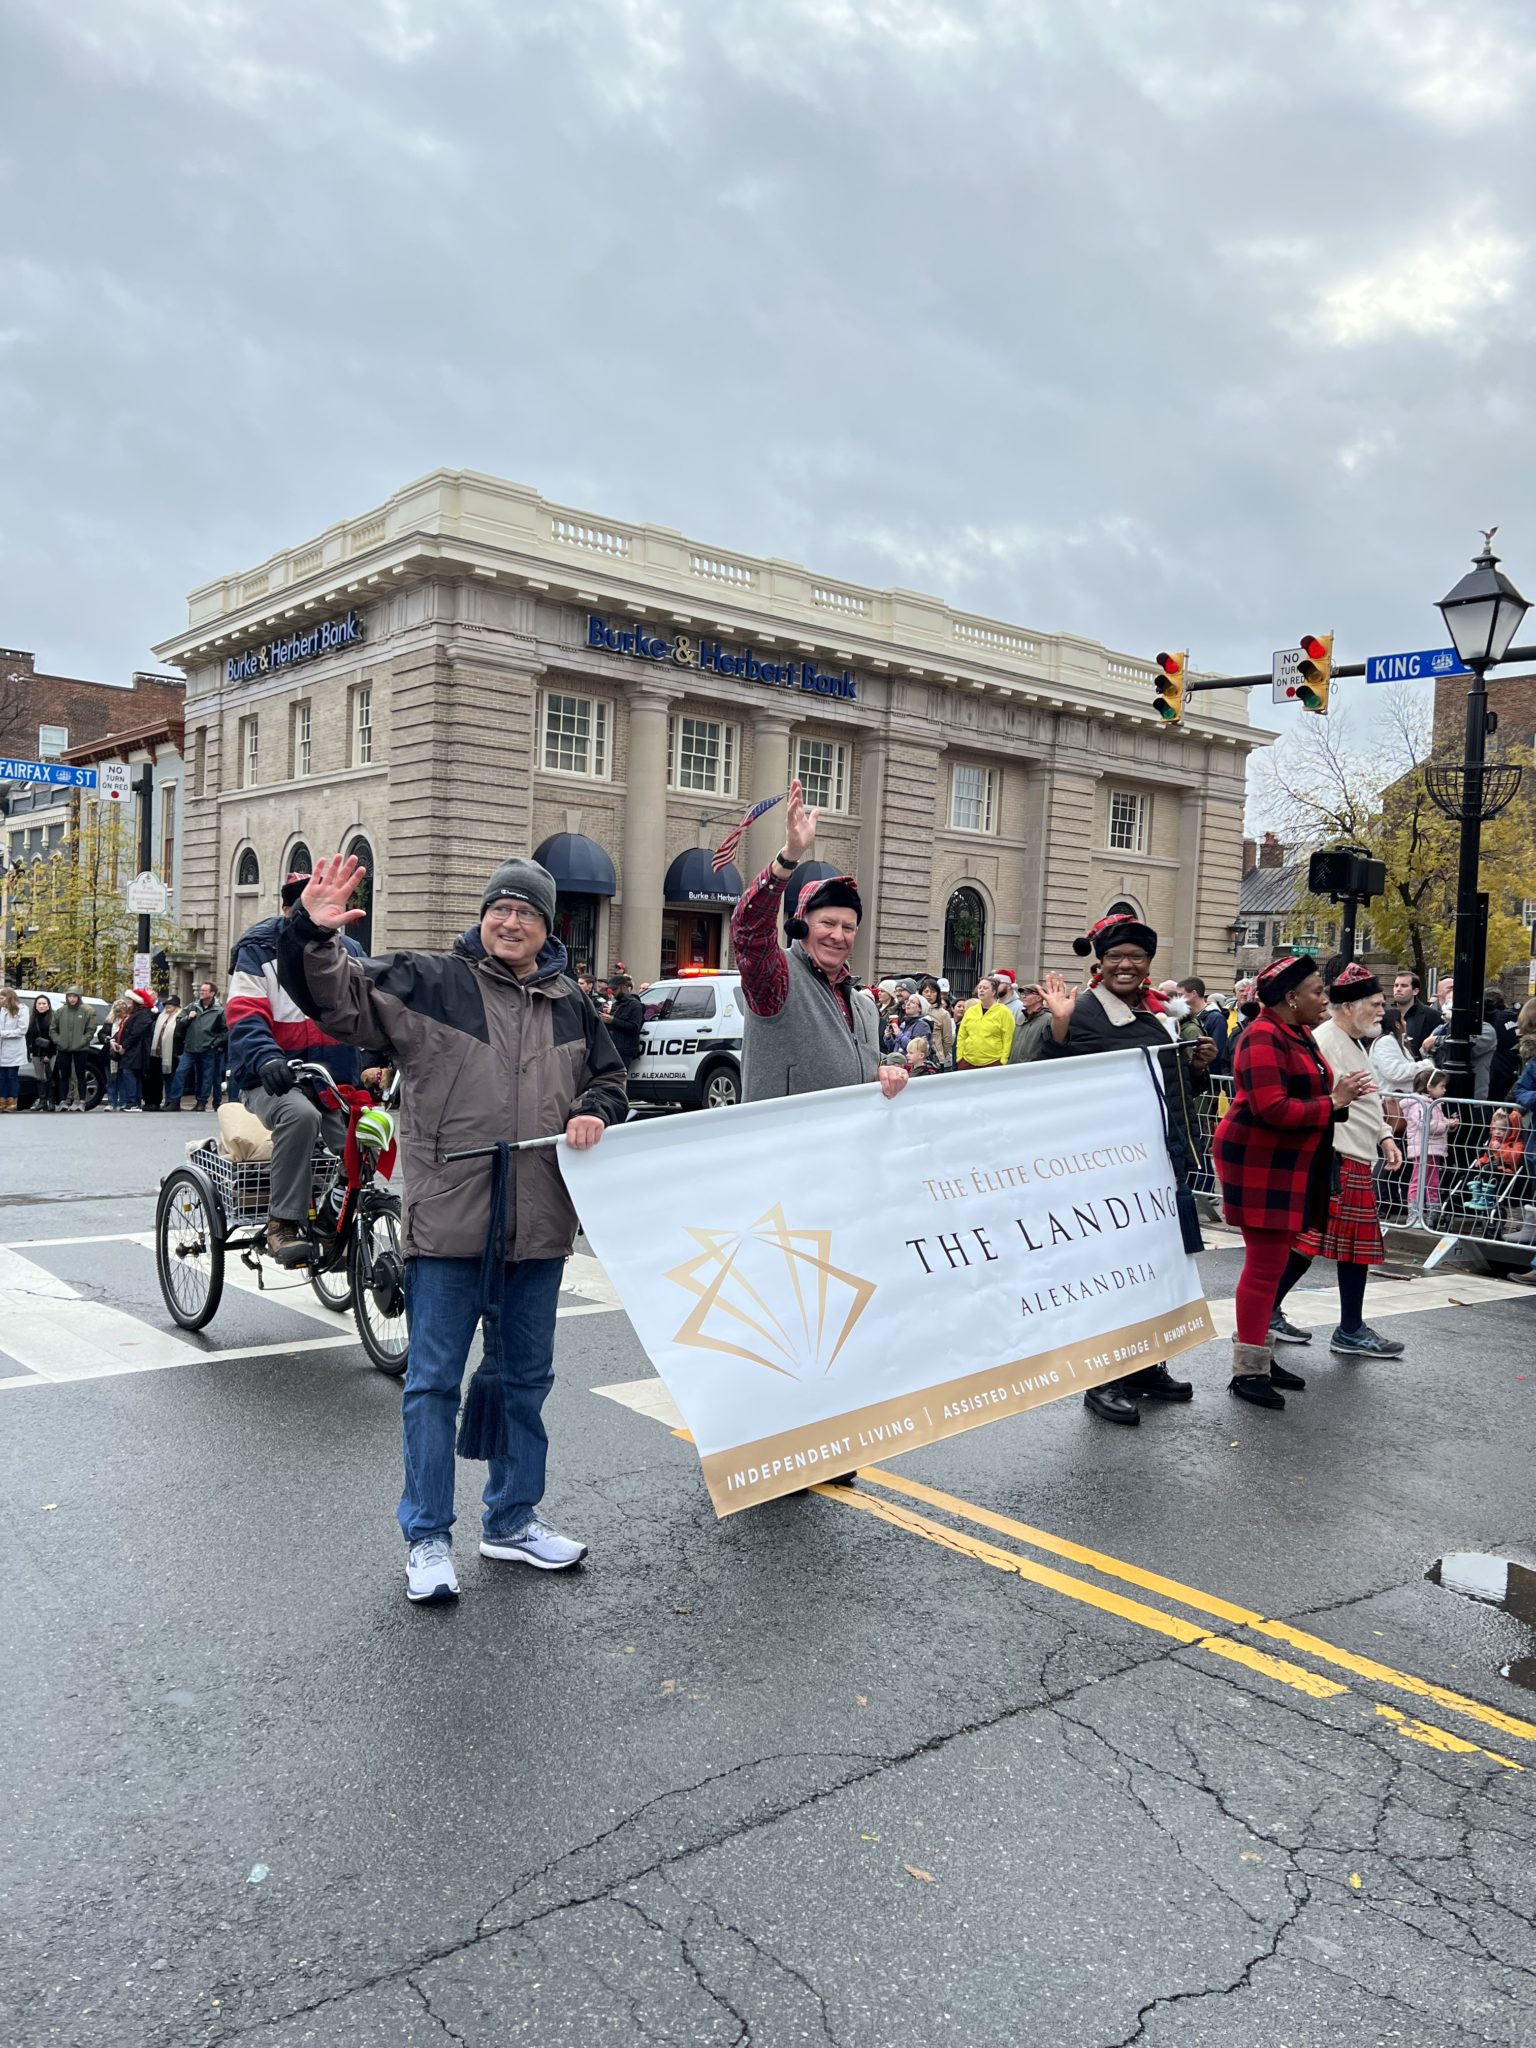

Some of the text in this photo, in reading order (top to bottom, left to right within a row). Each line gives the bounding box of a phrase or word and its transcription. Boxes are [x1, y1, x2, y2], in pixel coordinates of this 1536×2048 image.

[227, 611, 360, 680] Burke & Herbert Bank
[586, 614, 858, 701] Burke & Herbert Bank
[1280, 665, 1299, 675] TUR
[1283, 653, 1299, 664] NO
[1375, 655, 1421, 680] KING
[1276, 675, 1306, 687] ON RED
[0, 761, 93, 786] FAIRFAX ST
[105, 774, 125, 783] TURN
[108, 766, 123, 774] NO
[114, 783, 129, 791] RED
[688, 891, 709, 900] Burke
[922, 1143, 1148, 1202] THE ÉLITE COLLECTION
[905, 1185, 1177, 1274] THE LANDING
[1021, 1262, 1157, 1317] ALEXANDRIA
[727, 1316, 1205, 1492] INDEPENDENT LIVING ASSISTED LIVING THE BRIDGE MEMORY CARE
